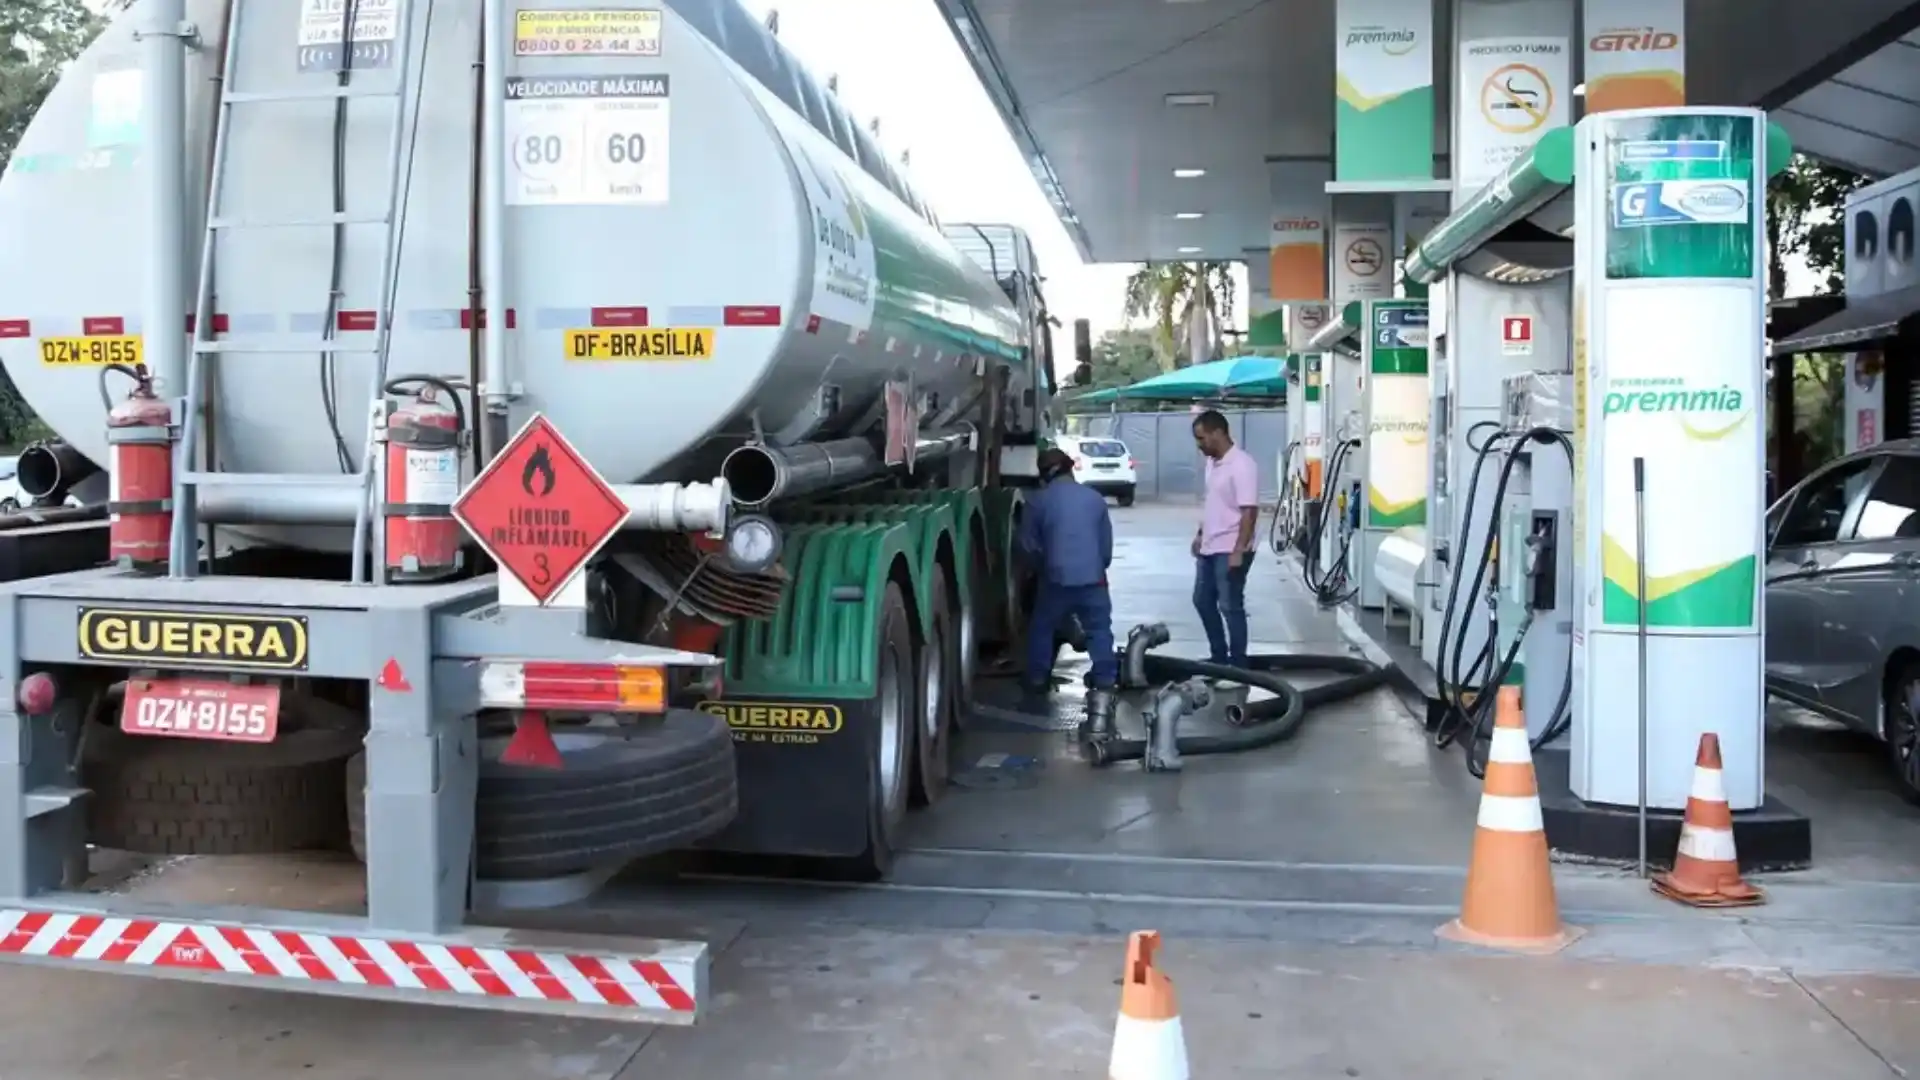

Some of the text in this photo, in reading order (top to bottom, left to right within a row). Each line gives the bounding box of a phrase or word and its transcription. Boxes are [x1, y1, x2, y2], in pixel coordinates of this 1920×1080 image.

[565, 39, 576, 51] 0
[635, 39, 657, 51] 33
[507, 76, 665, 97] VELOCIDADE MÁXIMA
[525, 135, 562, 164] 80
[608, 133, 646, 164] 60
[1621, 187, 1647, 217] G
[43, 341, 136, 363] OZW-8155
[574, 328, 705, 356] DF-BRASÍLIA
[1602, 384, 1742, 420] premmia
[509, 504, 571, 526] LÍQUIDO
[491, 526, 589, 549] INFLAMÁVEL
[532, 552, 551, 586] 3
[96, 618, 288, 658] GUERRA
[771, 733, 819, 744] ESTRADA
